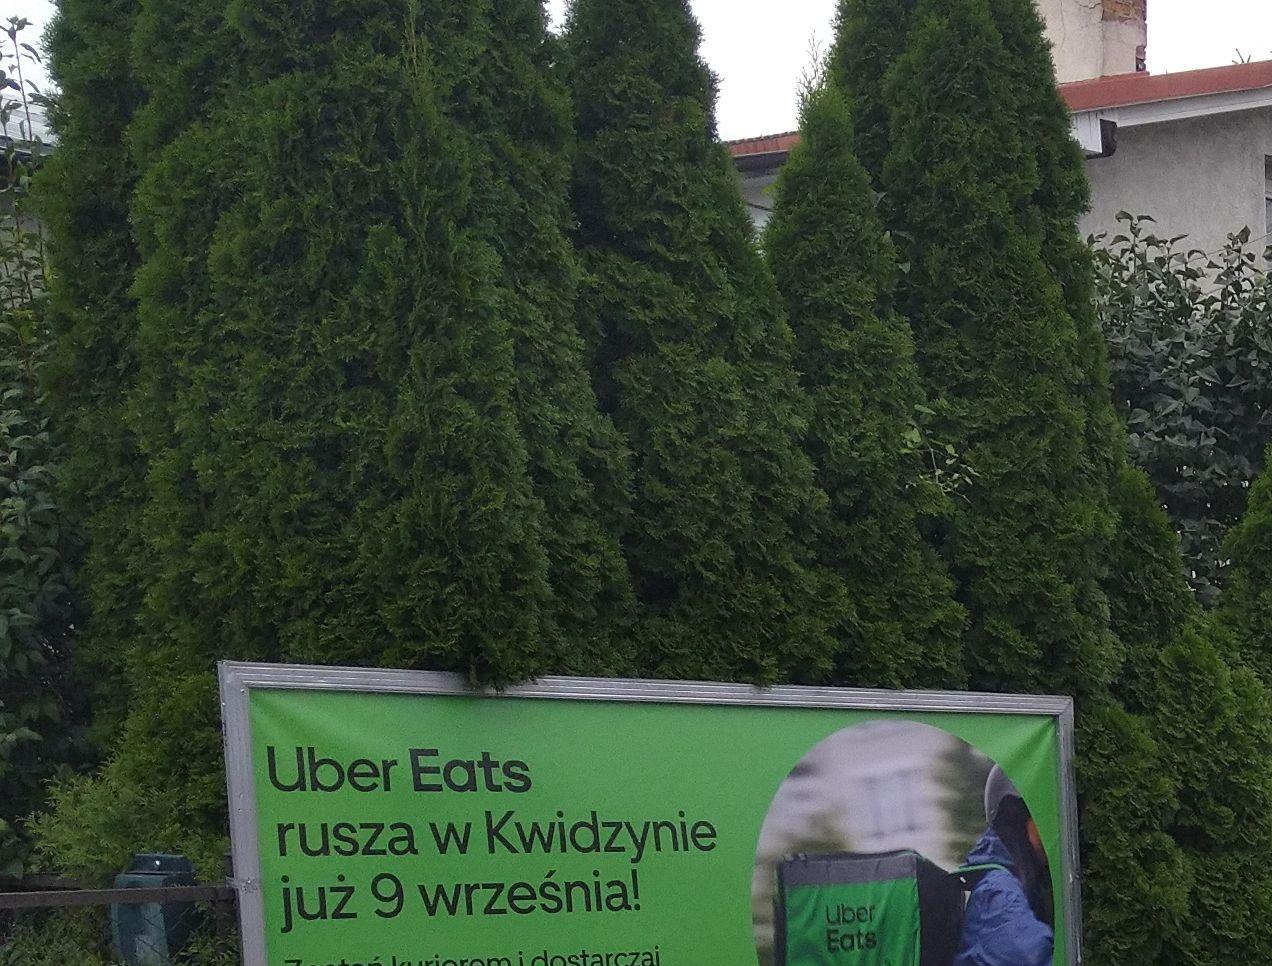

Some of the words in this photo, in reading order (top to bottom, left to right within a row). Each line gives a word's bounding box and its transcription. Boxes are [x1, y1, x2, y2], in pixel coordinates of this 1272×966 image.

[266, 745, 398, 793] Uber
[409, 748, 533, 793] Eats
[276, 821, 419, 857] rusza
[428, 821, 472, 855] w
[484, 810, 717, 864] Kwidzynie
[280, 874, 358, 934] już
[370, 872, 404, 919] 9
[416, 868, 641, 917] września!
[826, 904, 876, 925] Uber
[826, 929, 877, 954] Eats
